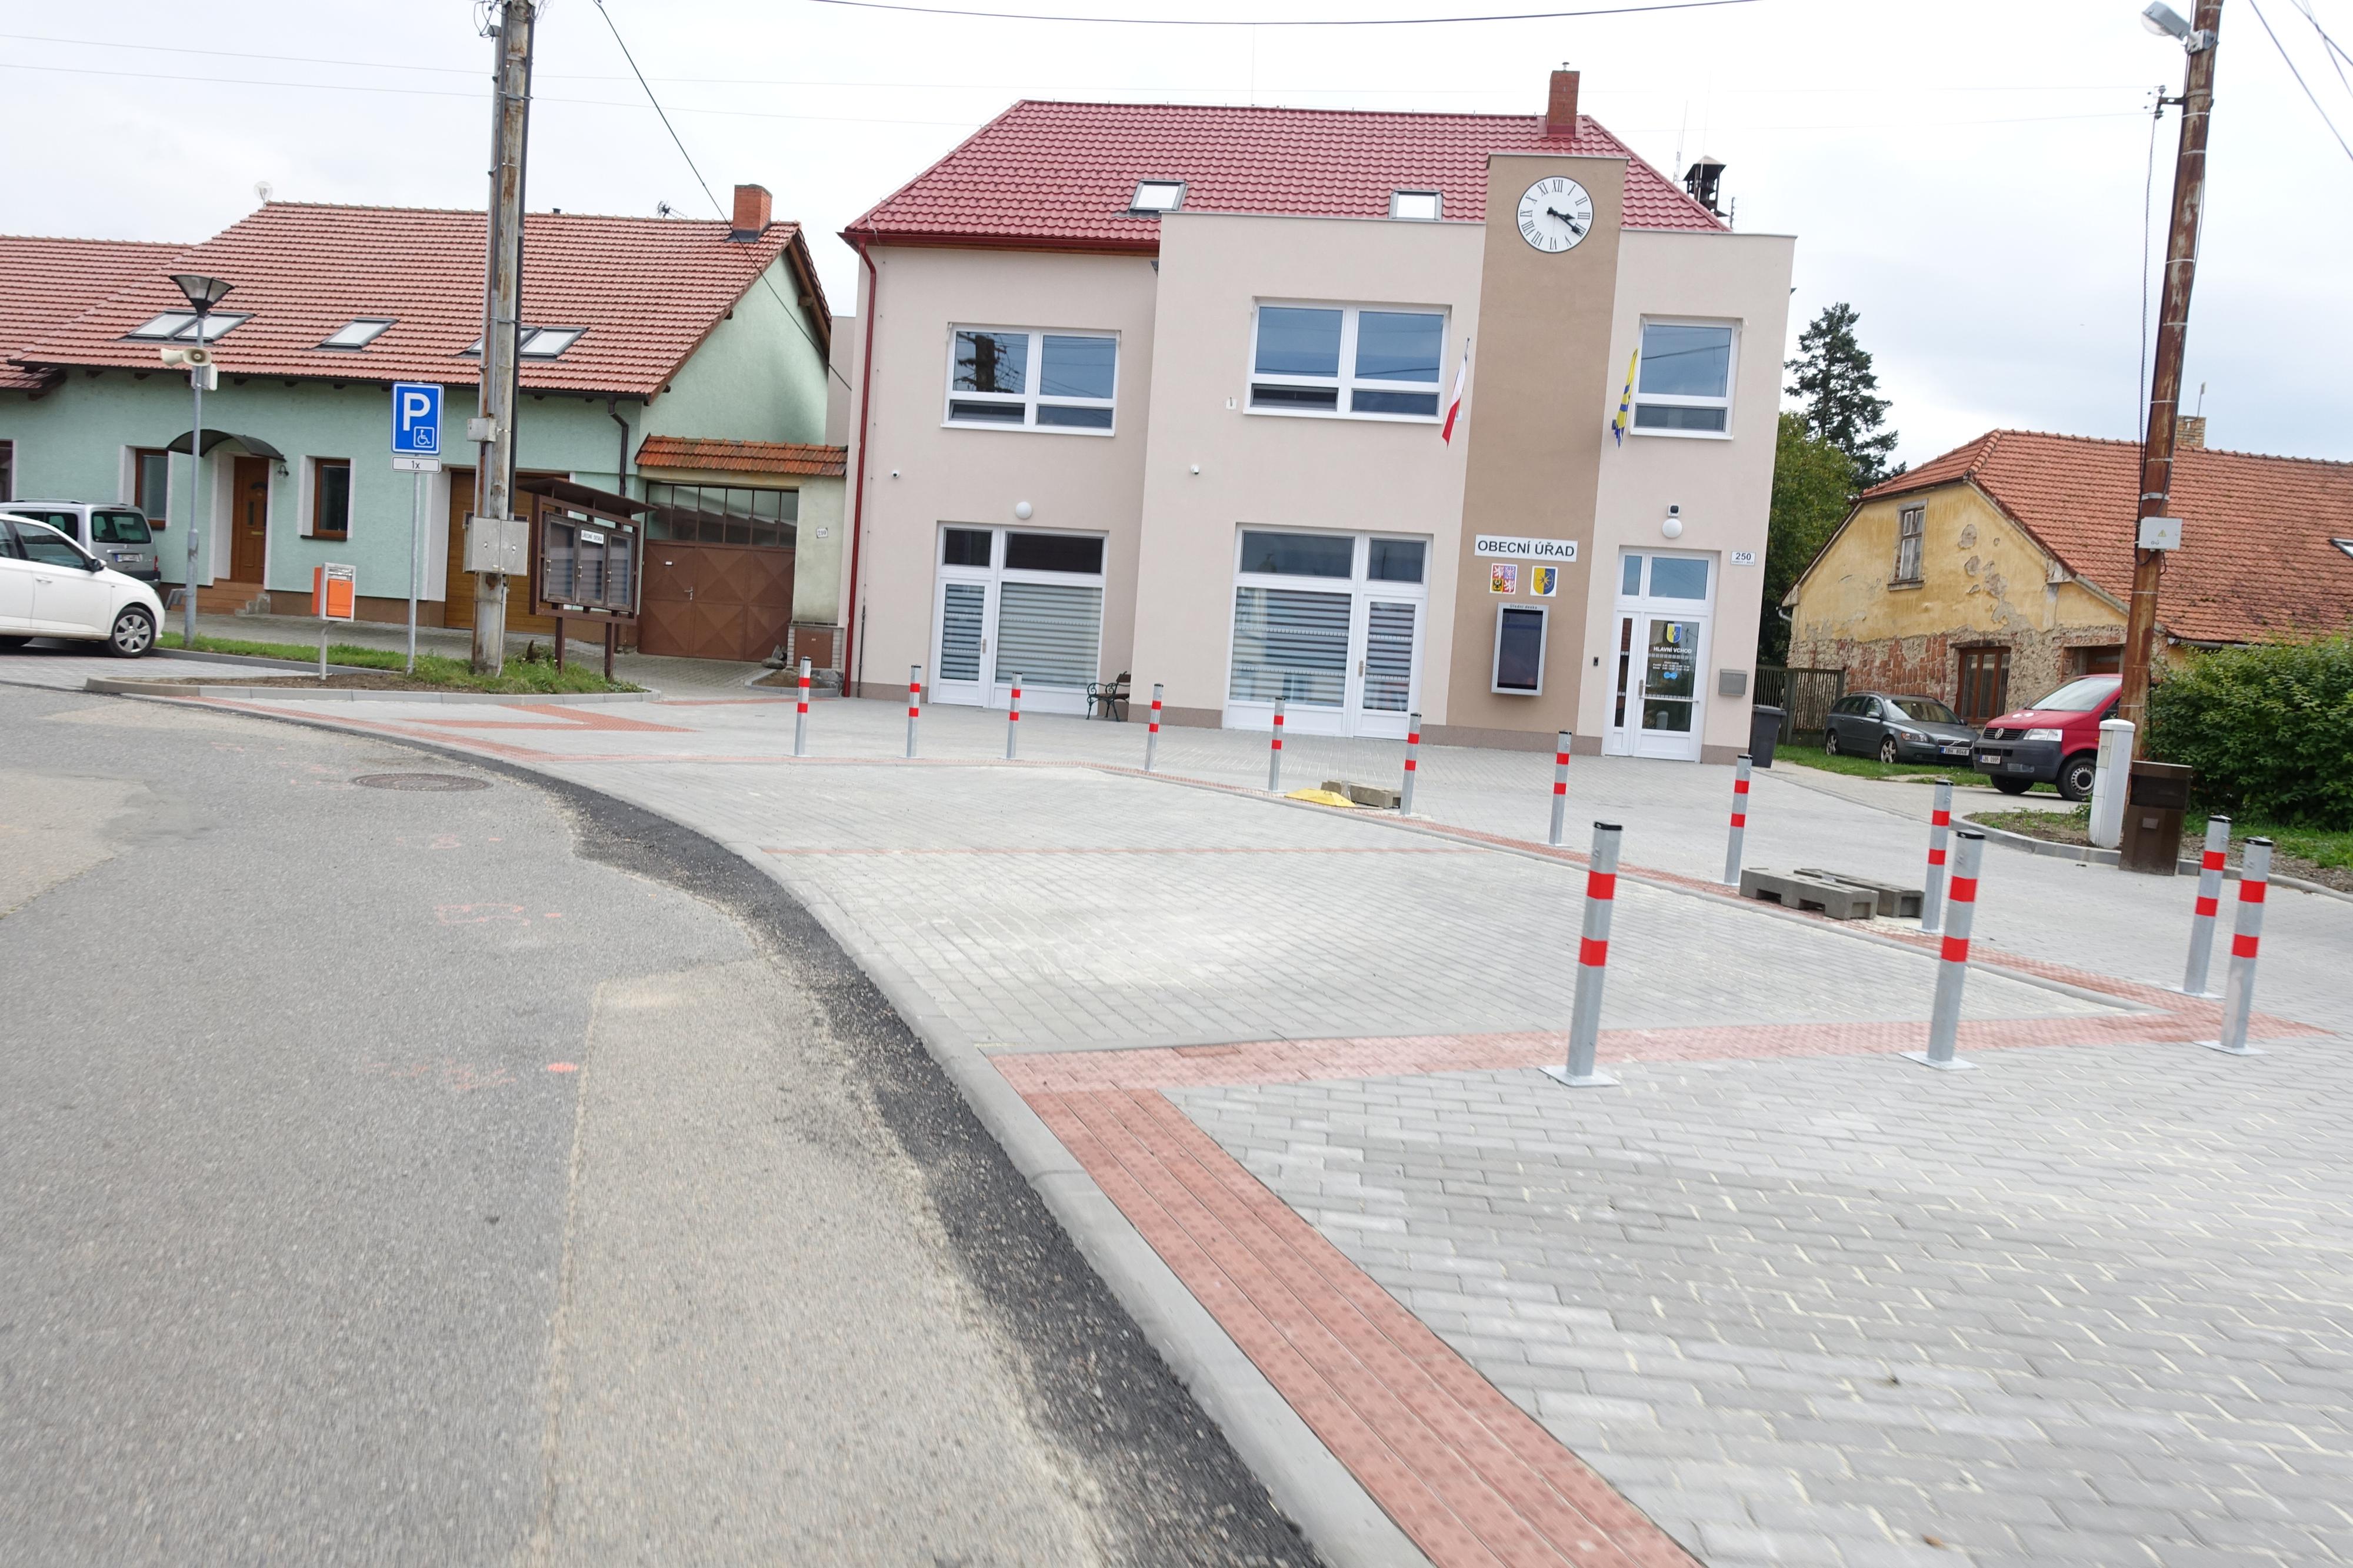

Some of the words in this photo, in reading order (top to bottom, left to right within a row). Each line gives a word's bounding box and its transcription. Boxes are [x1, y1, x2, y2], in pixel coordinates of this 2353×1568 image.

[1537, 182, 1549, 197] XI
[1552, 179, 1564, 193] XII
[1567, 184, 1577, 196] I
[1525, 194, 1538, 205] X
[1575, 196, 1588, 206] II
[1519, 209, 1533, 218] IX
[1577, 211, 1591, 220] III
[1521, 219, 1537, 236] VIII
[1531, 231, 1544, 246] VII
[1549, 236, 1557, 250] VI
[1564, 235, 1572, 247] V
[403, 392, 431, 431] P
[411, 460, 421, 469] 1x
[1478, 541, 1531, 554] OBECNÍ
[1535, 541, 1575, 556] ÚŘAD
[1735, 552, 1751, 561] 250
